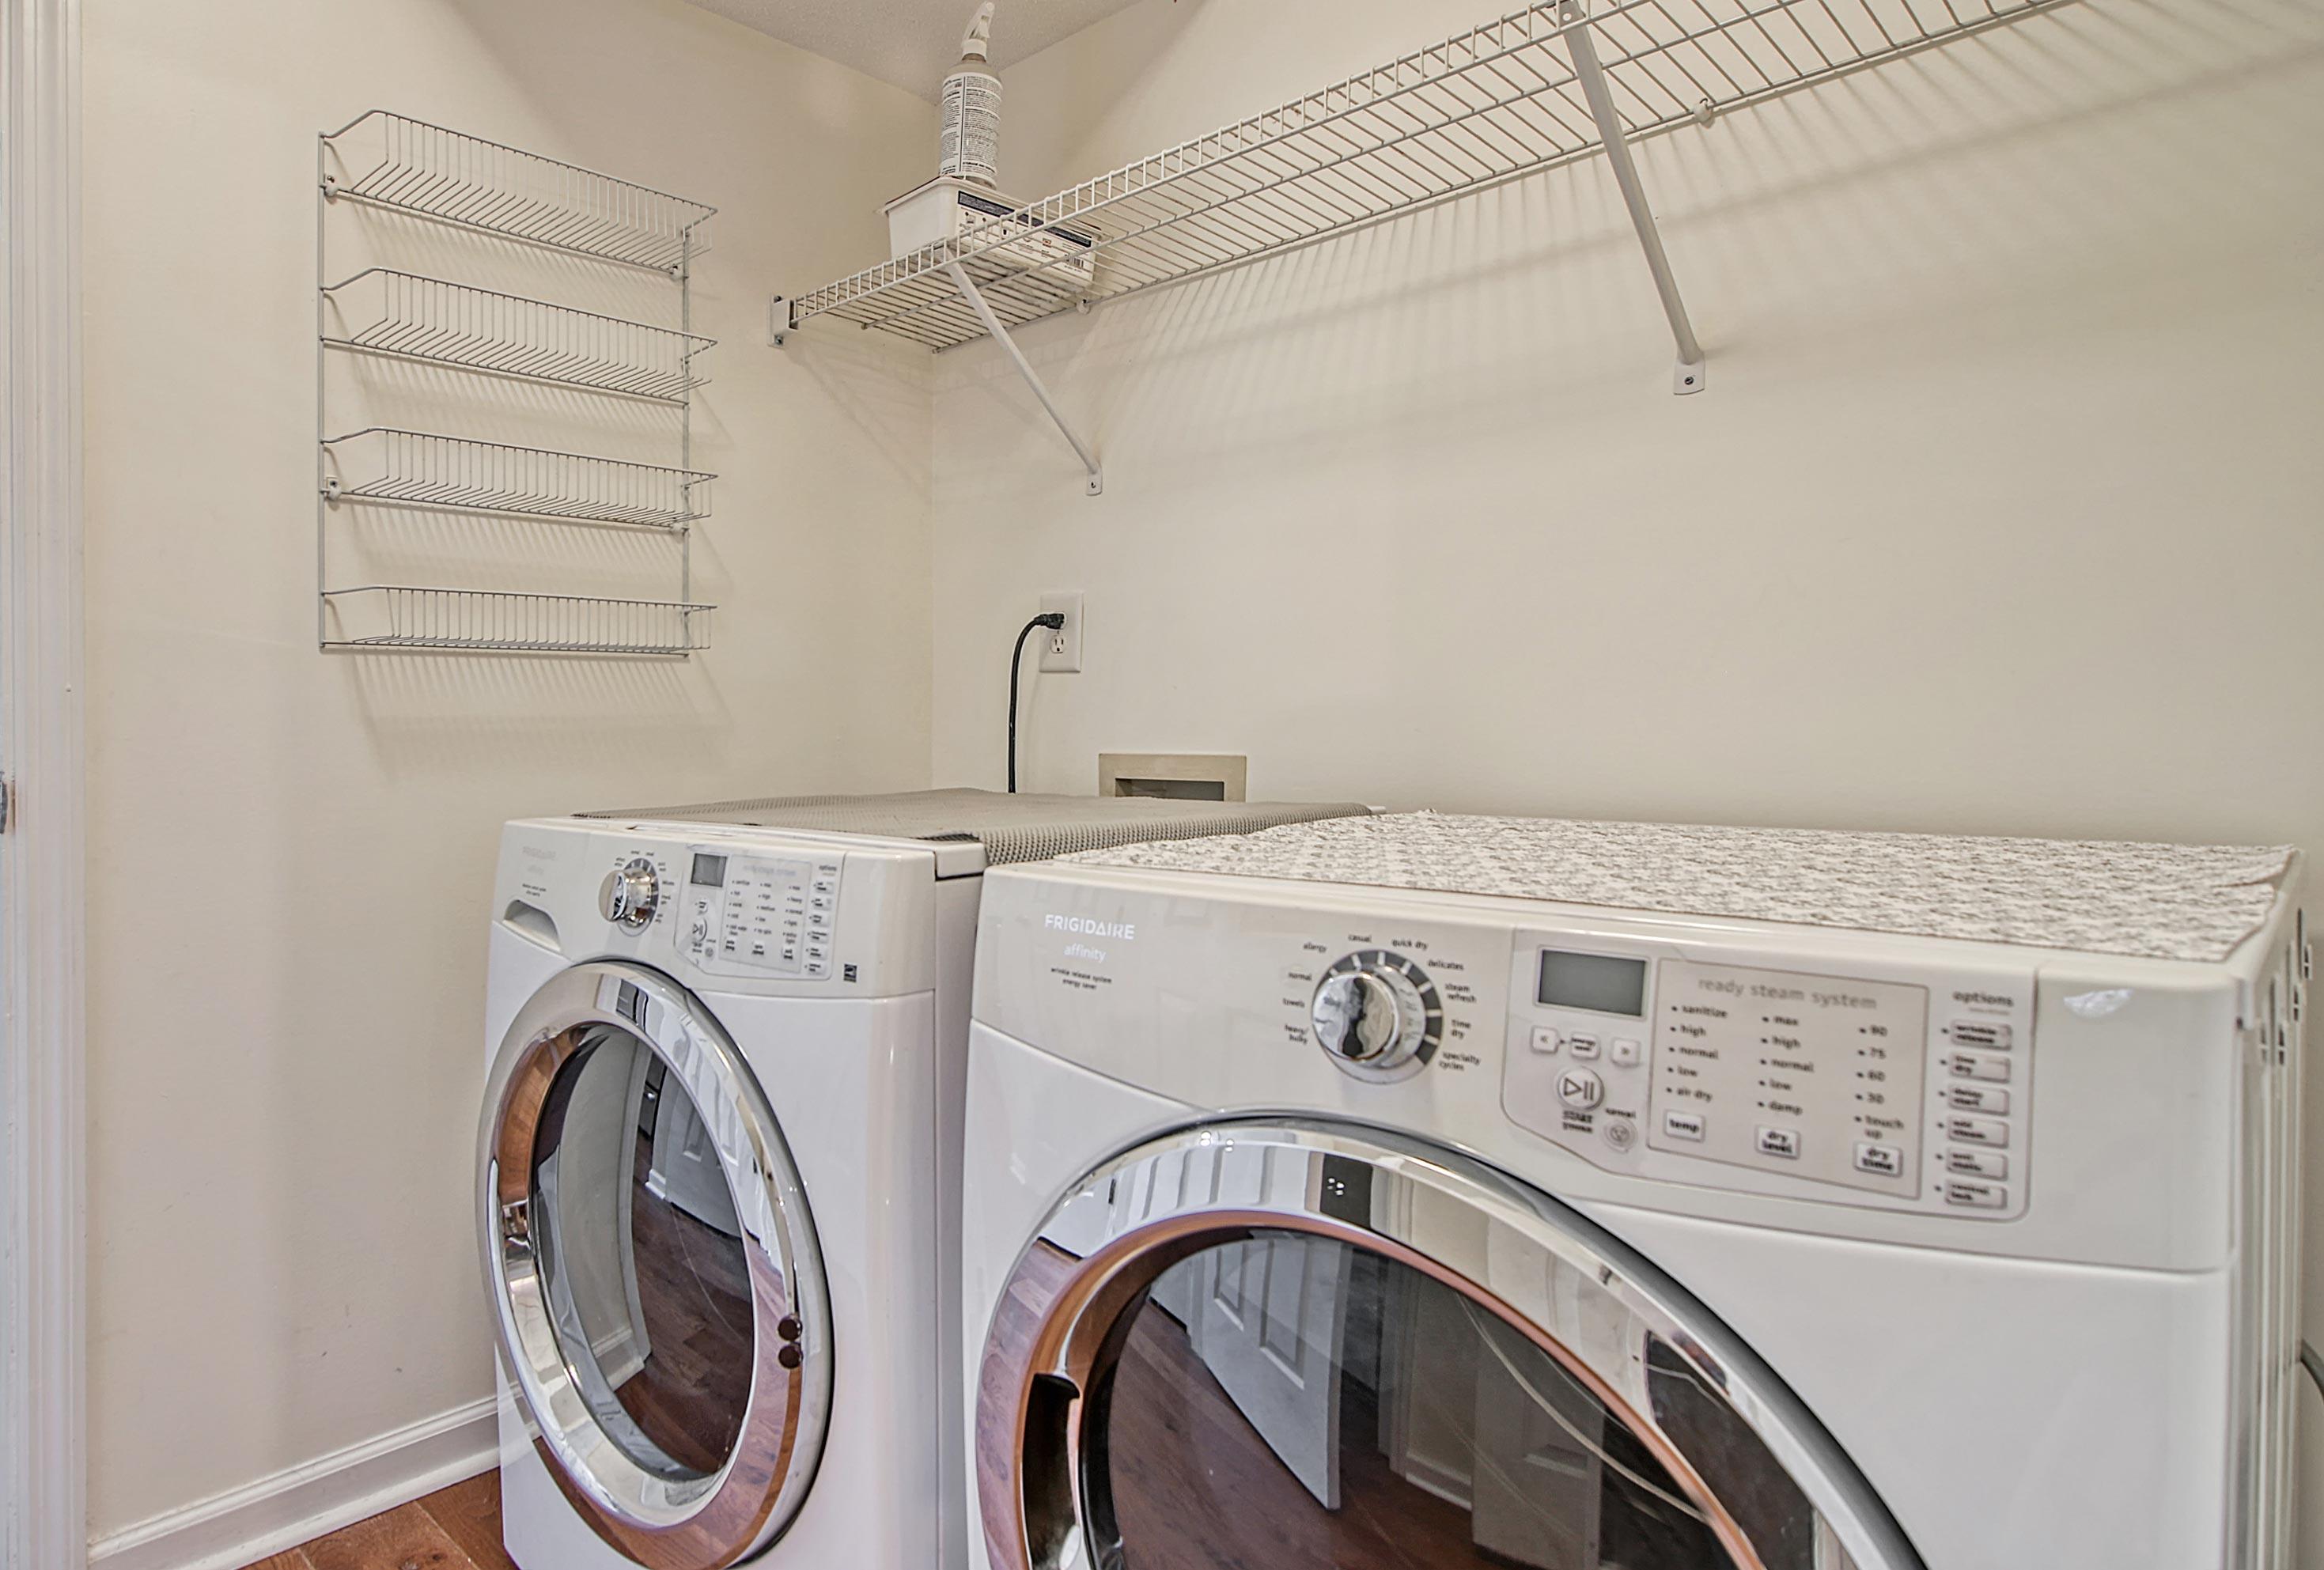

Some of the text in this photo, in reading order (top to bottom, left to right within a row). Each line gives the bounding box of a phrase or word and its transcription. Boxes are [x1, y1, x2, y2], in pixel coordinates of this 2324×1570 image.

[1045, 914, 1135, 940] FRIGIDAIRE
[1348, 935, 1372, 944] casual
[1392, 939, 1429, 951] quick dry
[1064, 943, 1106, 963] affinity
[1303, 941, 1327, 953] allergy
[1428, 959, 1465, 971] delicates
[1289, 972, 1312, 982] normal
[1444, 983, 1470, 993] steam
[1698, 979, 1878, 1010] ready steam system
[1953, 990, 2013, 1007] options
[1681, 1004, 1728, 1019] sanitize
[1773, 1016, 1799, 1027] max
[1451, 1029, 1465, 1040] dry
[1680, 1024, 1706, 1038] high
[1772, 1035, 1800, 1050] high
[1442, 1051, 1481, 1065] specialty
[1679, 1046, 1720, 1060] normal
[1869, 1047, 1887, 1060] 75
[1438, 1061, 1465, 1072] cycles
[1677, 1065, 1698, 1078] low
[1770, 1057, 1815, 1073] normal
[1868, 1069, 1886, 1082] 60
[1769, 1079, 1792, 1091] low
[1676, 1088, 1713, 1103] air dry
[1867, 1092, 1885, 1105] 30
[1768, 1100, 1803, 1116] damp
[1668, 1118, 1700, 1133] temp
[1865, 1115, 1904, 1129] touch
[1767, 1130, 1788, 1144] dry
[1864, 1129, 1883, 1140] up
[1762, 1139, 1793, 1154] level
[1867, 1148, 1890, 1160] dry
[1862, 1157, 1894, 1171] time
